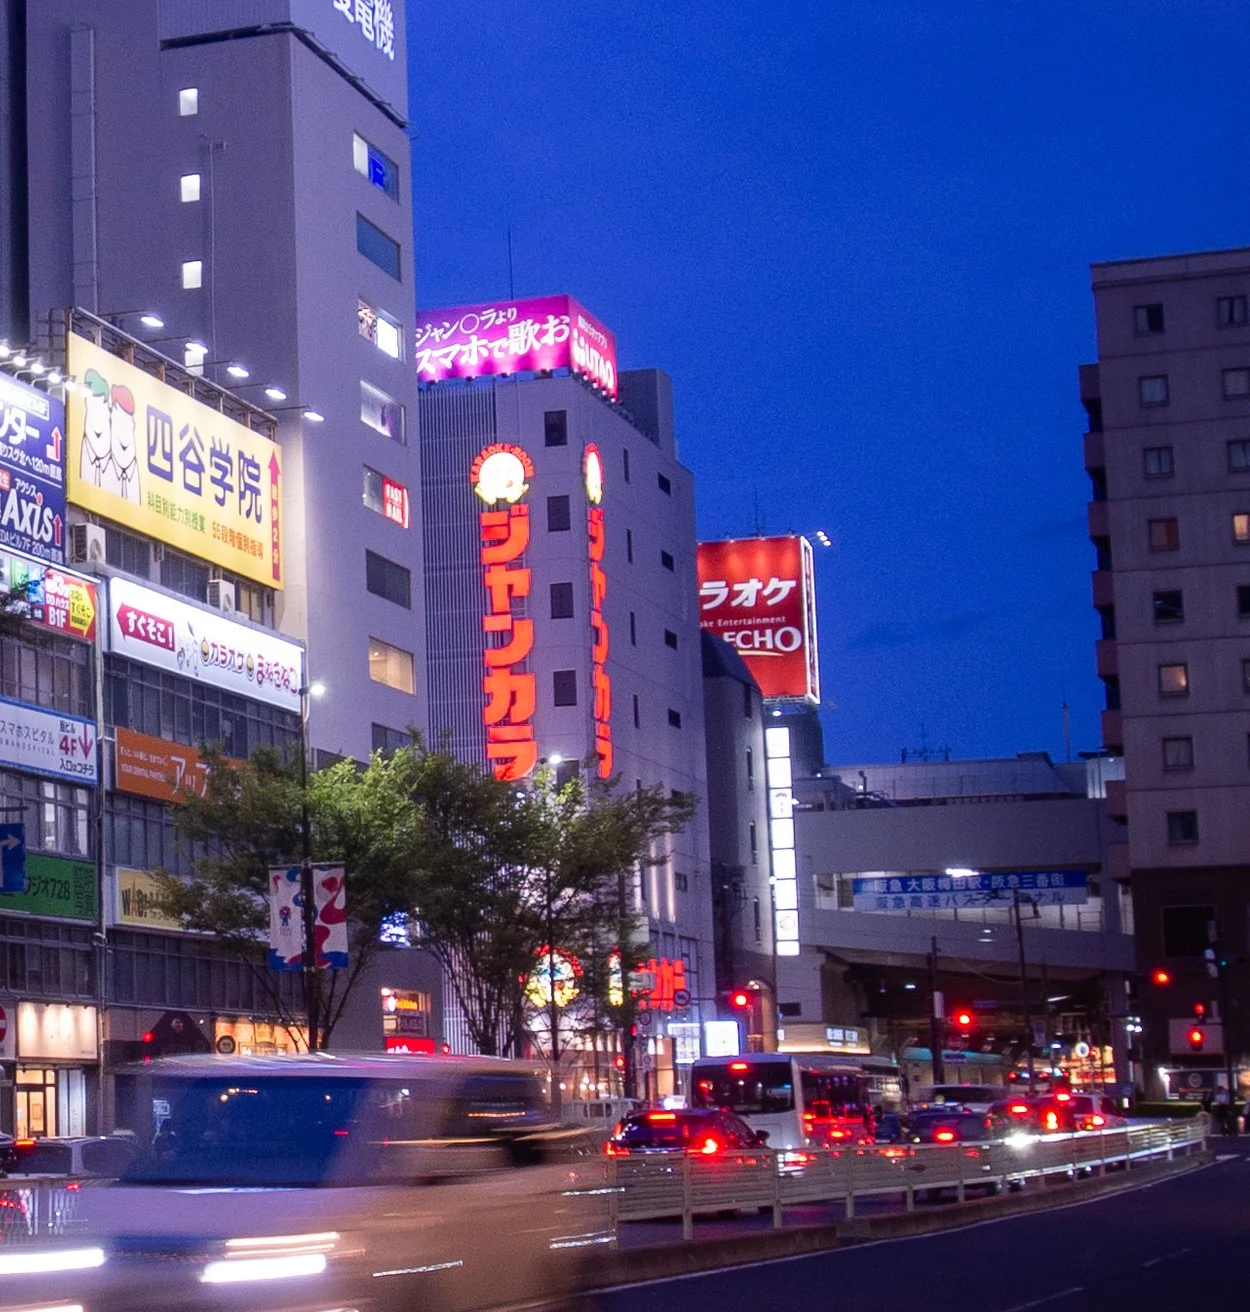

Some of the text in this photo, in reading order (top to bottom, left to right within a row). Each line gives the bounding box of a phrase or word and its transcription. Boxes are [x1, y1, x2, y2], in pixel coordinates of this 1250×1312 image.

[146, 404, 262, 524] 四谷学院
[49, 610, 66, 628] B1F
[479, 503, 538, 782] ジャンカラ
[588, 507, 613, 779] ジャンカラ
[718, 616, 786, 627] Entertainment
[59, 735, 77, 757] 4F
